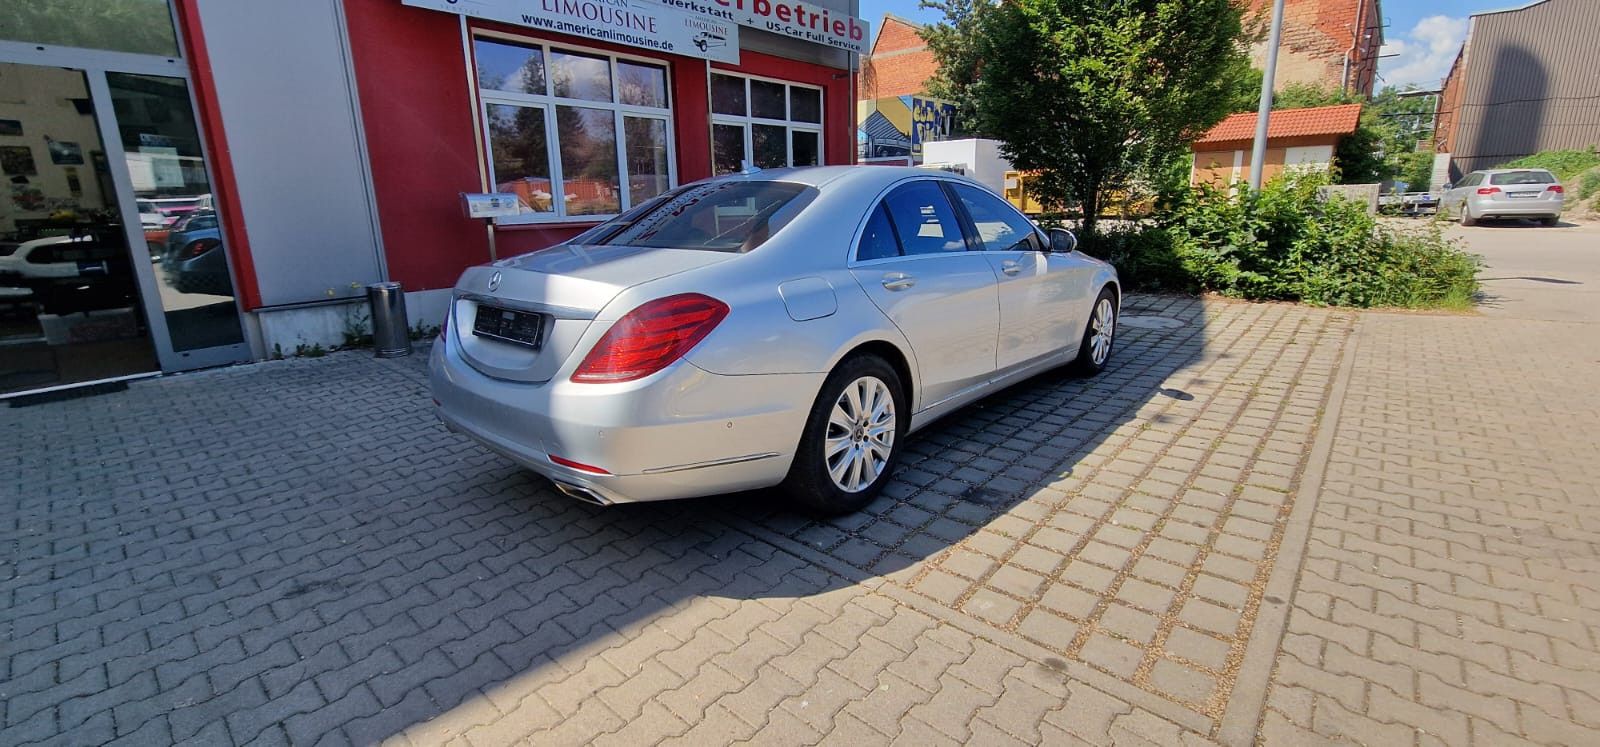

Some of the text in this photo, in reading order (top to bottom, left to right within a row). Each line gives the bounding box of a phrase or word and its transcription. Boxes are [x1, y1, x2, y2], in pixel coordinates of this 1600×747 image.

[521, 13, 674, 51] www.americanlimousine.de
[542, 0, 657, 34] LIMOUSINE
[766, 21, 802, 37] US-Car
[806, 31, 825, 43] Full
